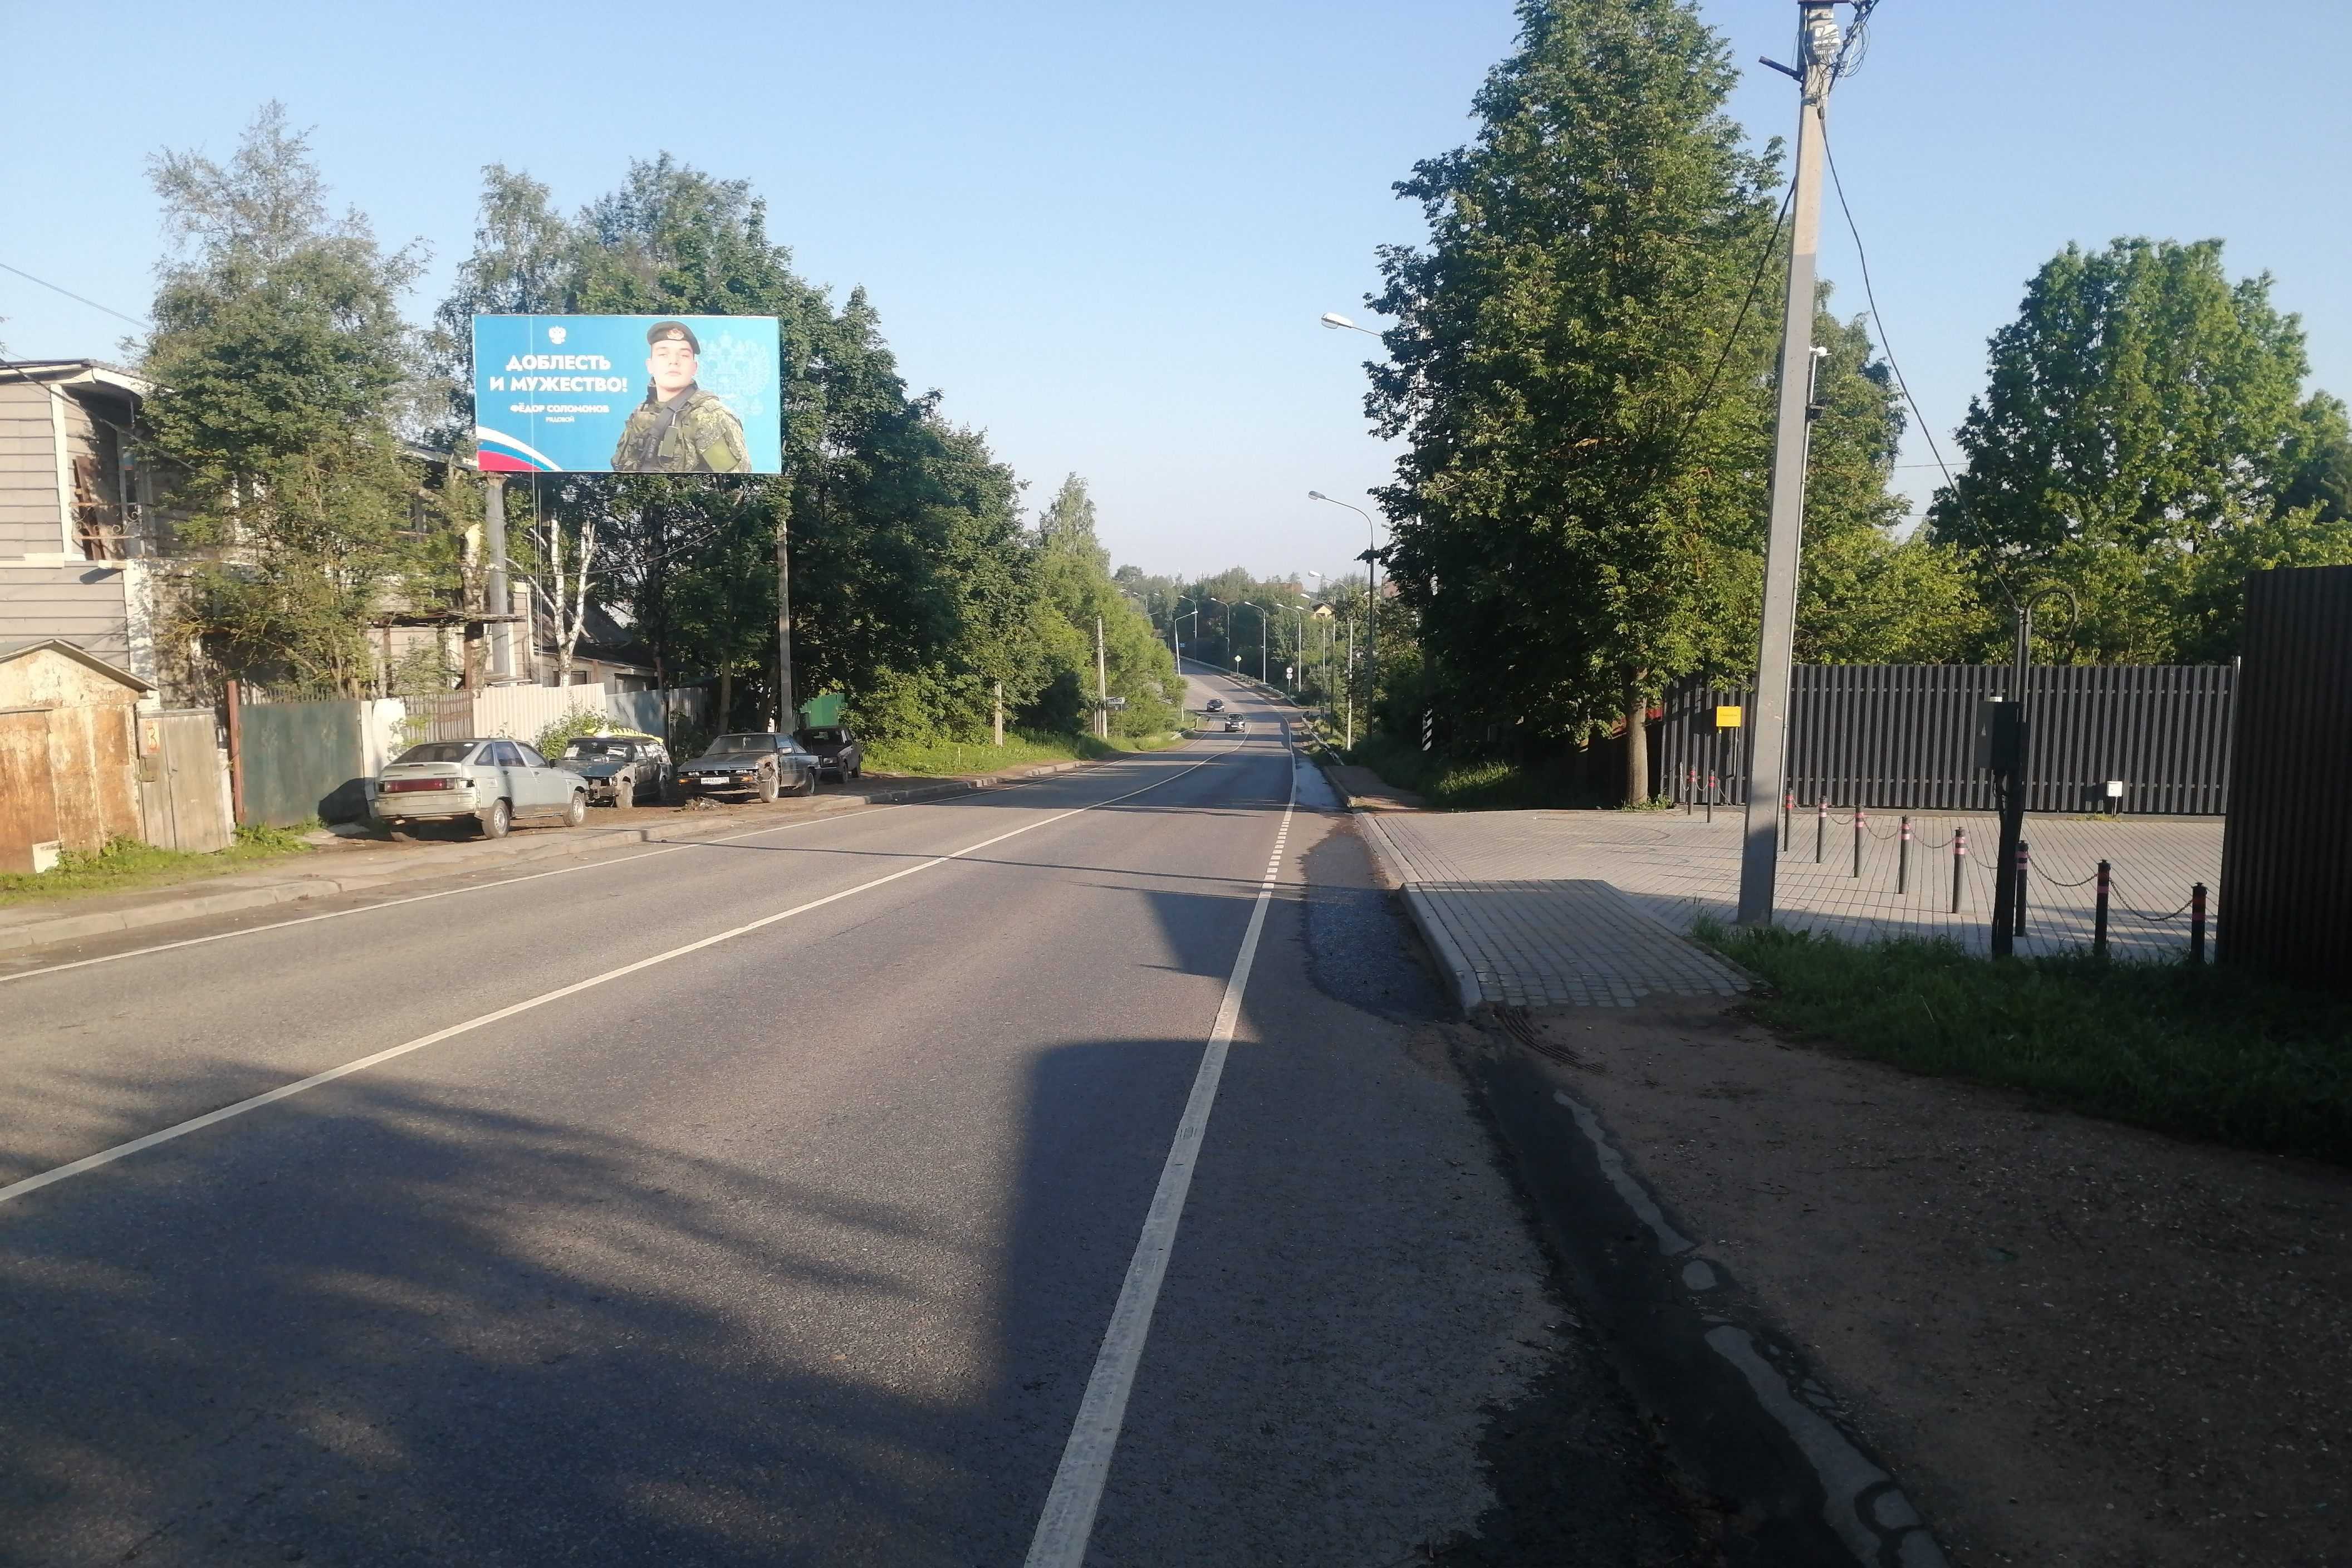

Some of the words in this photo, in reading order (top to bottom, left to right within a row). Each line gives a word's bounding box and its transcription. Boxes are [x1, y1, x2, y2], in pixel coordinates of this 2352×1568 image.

[506, 355, 611, 371] ДОБЛЕСТЬ
[489, 376, 504, 391] И
[510, 376, 628, 393] МУЖЕСТВО!
[509, 401, 545, 413] ФЁДОР
[546, 404, 610, 413] СОЛОМОНОВ
